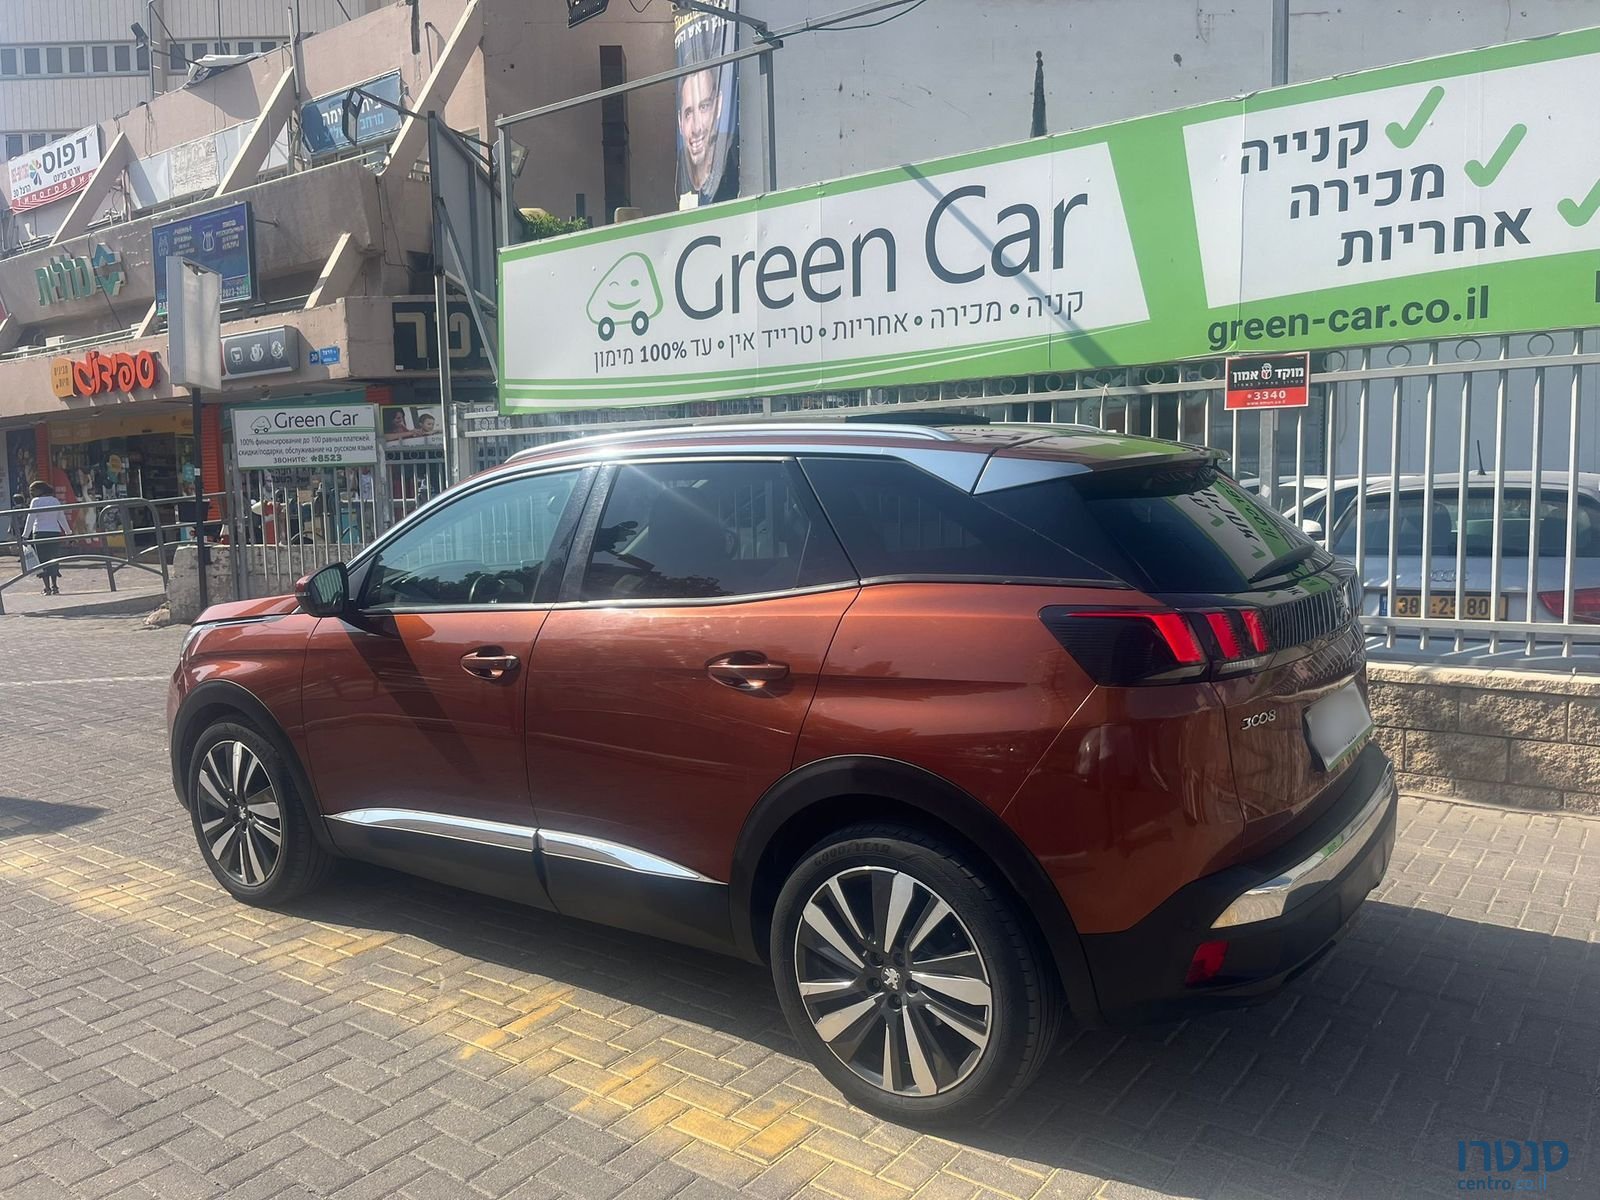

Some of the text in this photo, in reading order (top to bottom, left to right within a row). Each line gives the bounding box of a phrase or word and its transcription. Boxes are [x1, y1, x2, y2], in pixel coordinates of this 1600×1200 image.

[42, 136, 88, 174] דפוס
[1241, 119, 1369, 174] קנייה
[1290, 163, 1445, 219] מכירה
[675, 185, 1088, 320] Green Car
[1337, 207, 1532, 267] אחריות
[34, 254, 96, 306] כללית
[594, 291, 1084, 373] קניה מכירה אחריות טרייד אין עד 100% מימון
[1208, 285, 1489, 350] green-car.co.il
[1232, 367, 1304, 384] מוקד אמון
[274, 410, 359, 429] Green Car
[273, 456, 308, 464] звоните:
[1241, 709, 1277, 731] 3008
